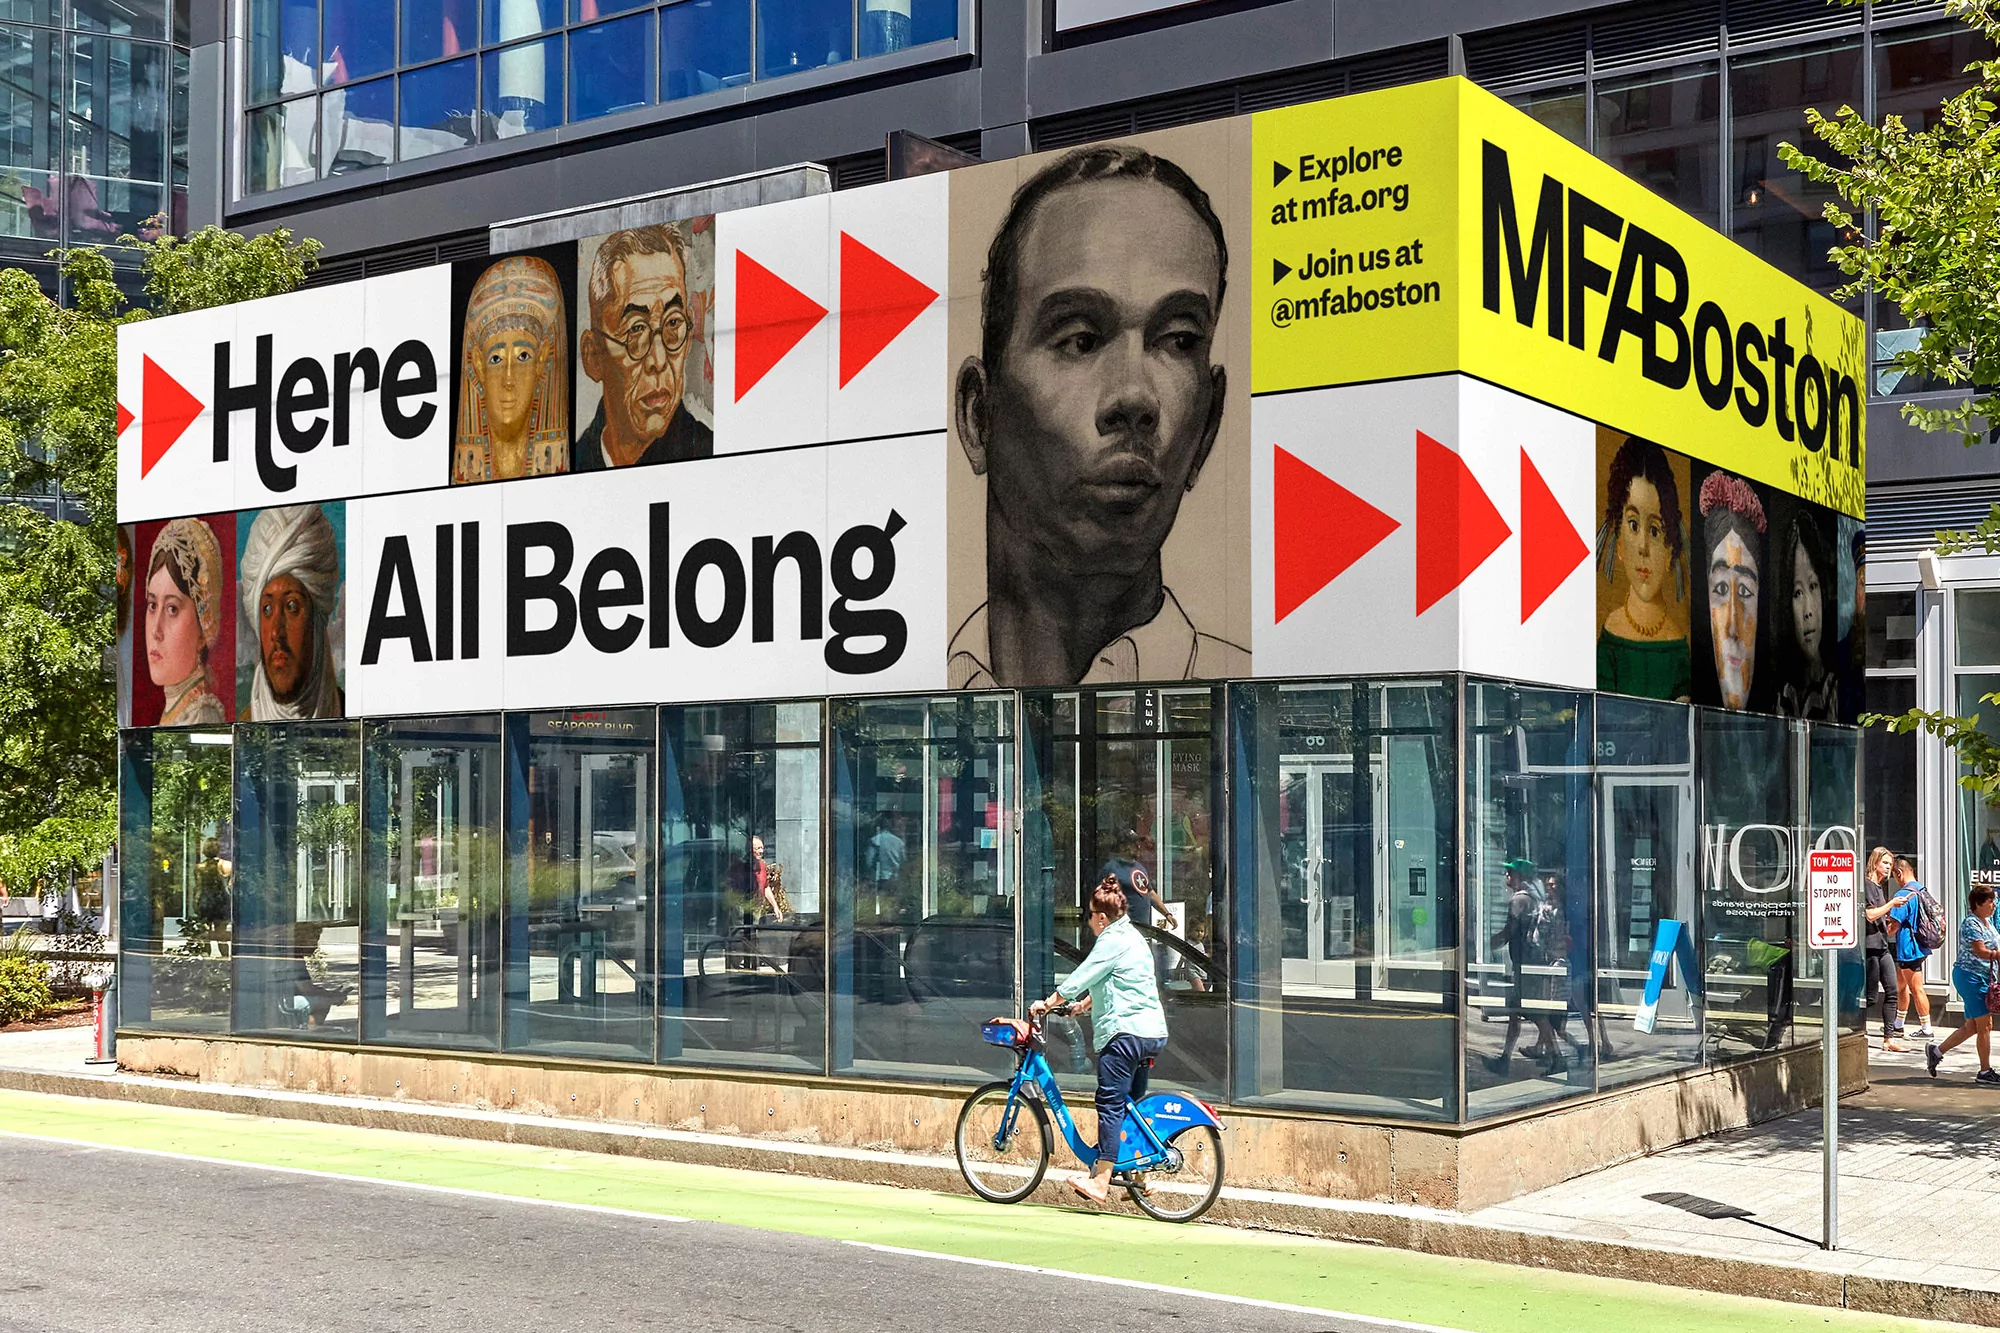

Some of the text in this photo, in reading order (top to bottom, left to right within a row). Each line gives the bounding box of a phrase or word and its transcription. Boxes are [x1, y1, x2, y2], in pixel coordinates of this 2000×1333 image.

[1300, 146, 1403, 183] Explore
[1271, 184, 1409, 225] at mfa.org
[1298, 239, 1423, 281] Join us at
[1271, 280, 1441, 329] @mfaboston
[213, 333, 438, 493] Here
[361, 501, 908, 675] All Belong
[1812, 857, 1829, 867] TOW
[1826, 875, 1839, 884] NO
[1813, 889, 1852, 898] STOPPING
[1824, 903, 1842, 912] ANY
[1824, 916, 1842, 926] TIME
